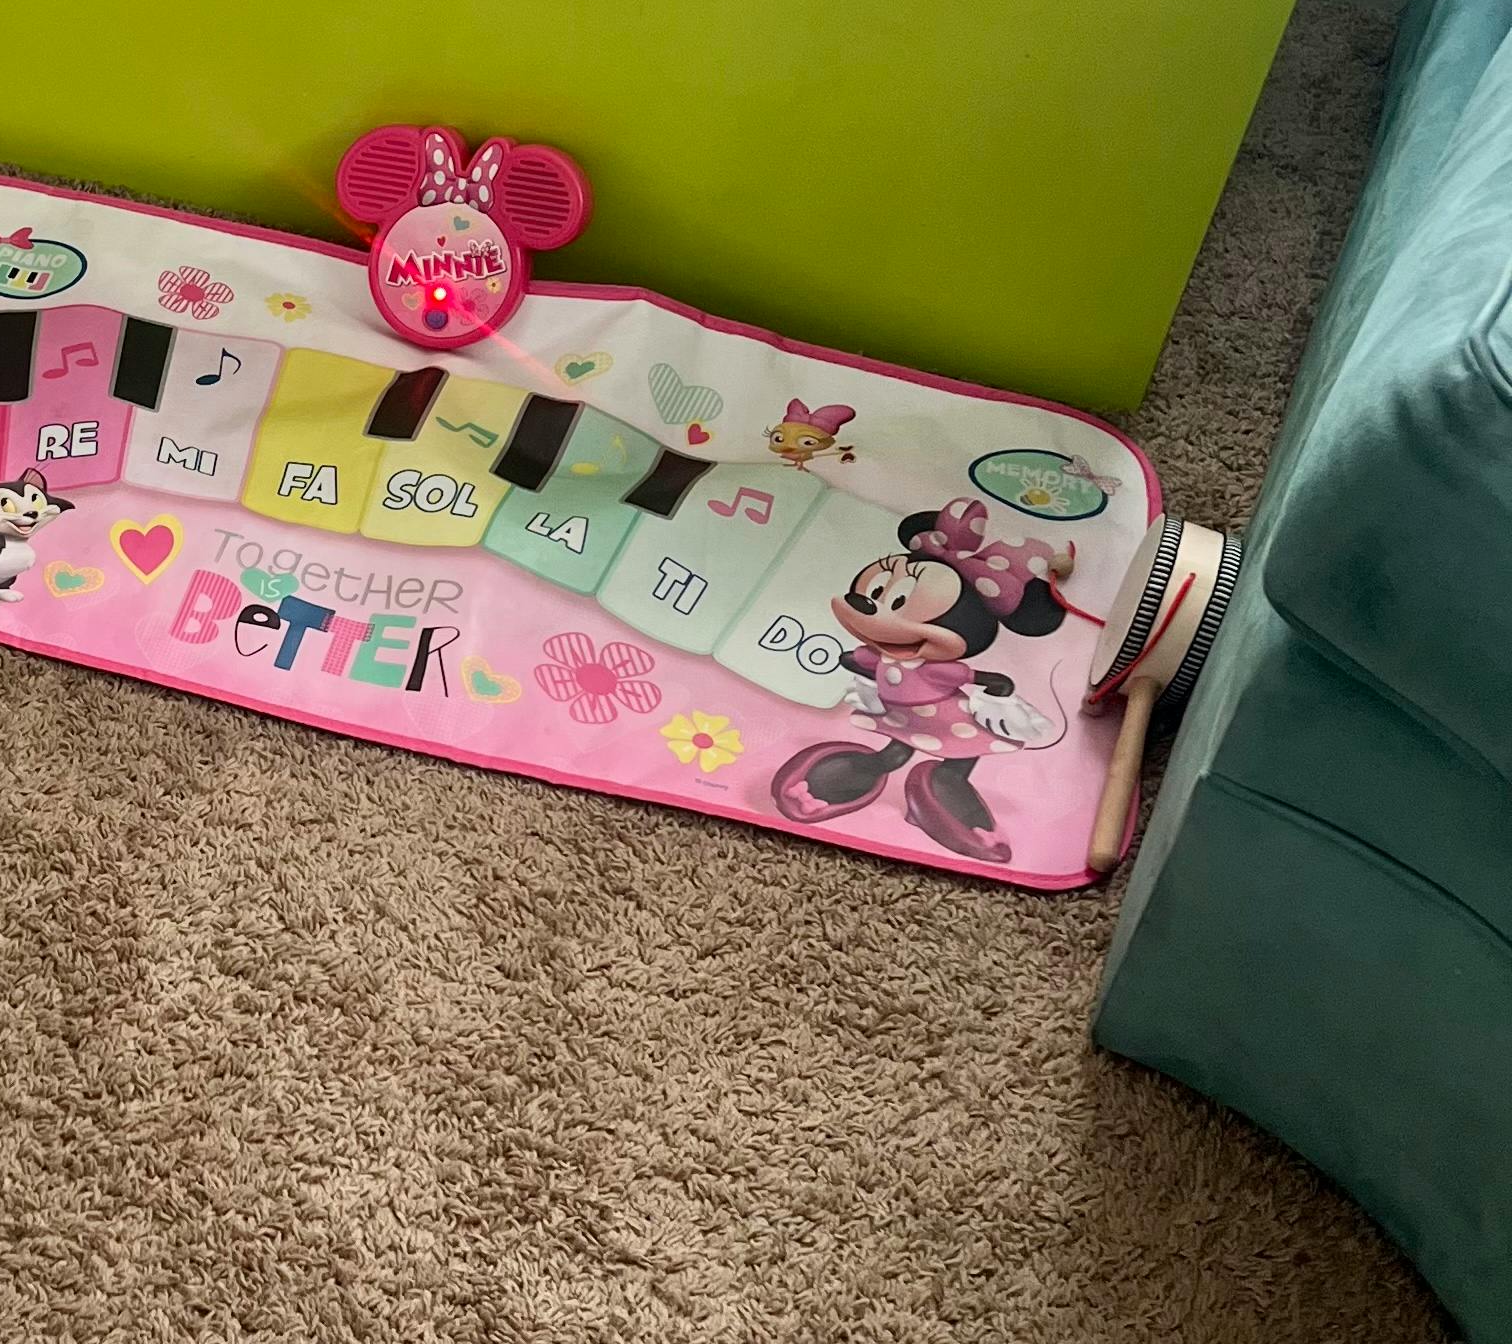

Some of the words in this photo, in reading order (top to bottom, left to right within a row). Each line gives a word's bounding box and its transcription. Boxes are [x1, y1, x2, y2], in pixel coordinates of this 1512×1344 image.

[386, 245, 507, 287] MINNIE
[36, 421, 99, 462] RE
[157, 436, 219, 477] MI
[277, 461, 339, 505] FA
[382, 469, 478, 518] SOL
[525, 511, 589, 554] LA
[259, 578, 281, 598] IS
[652, 556, 708, 615] TI
[758, 615, 843, 675] DO
